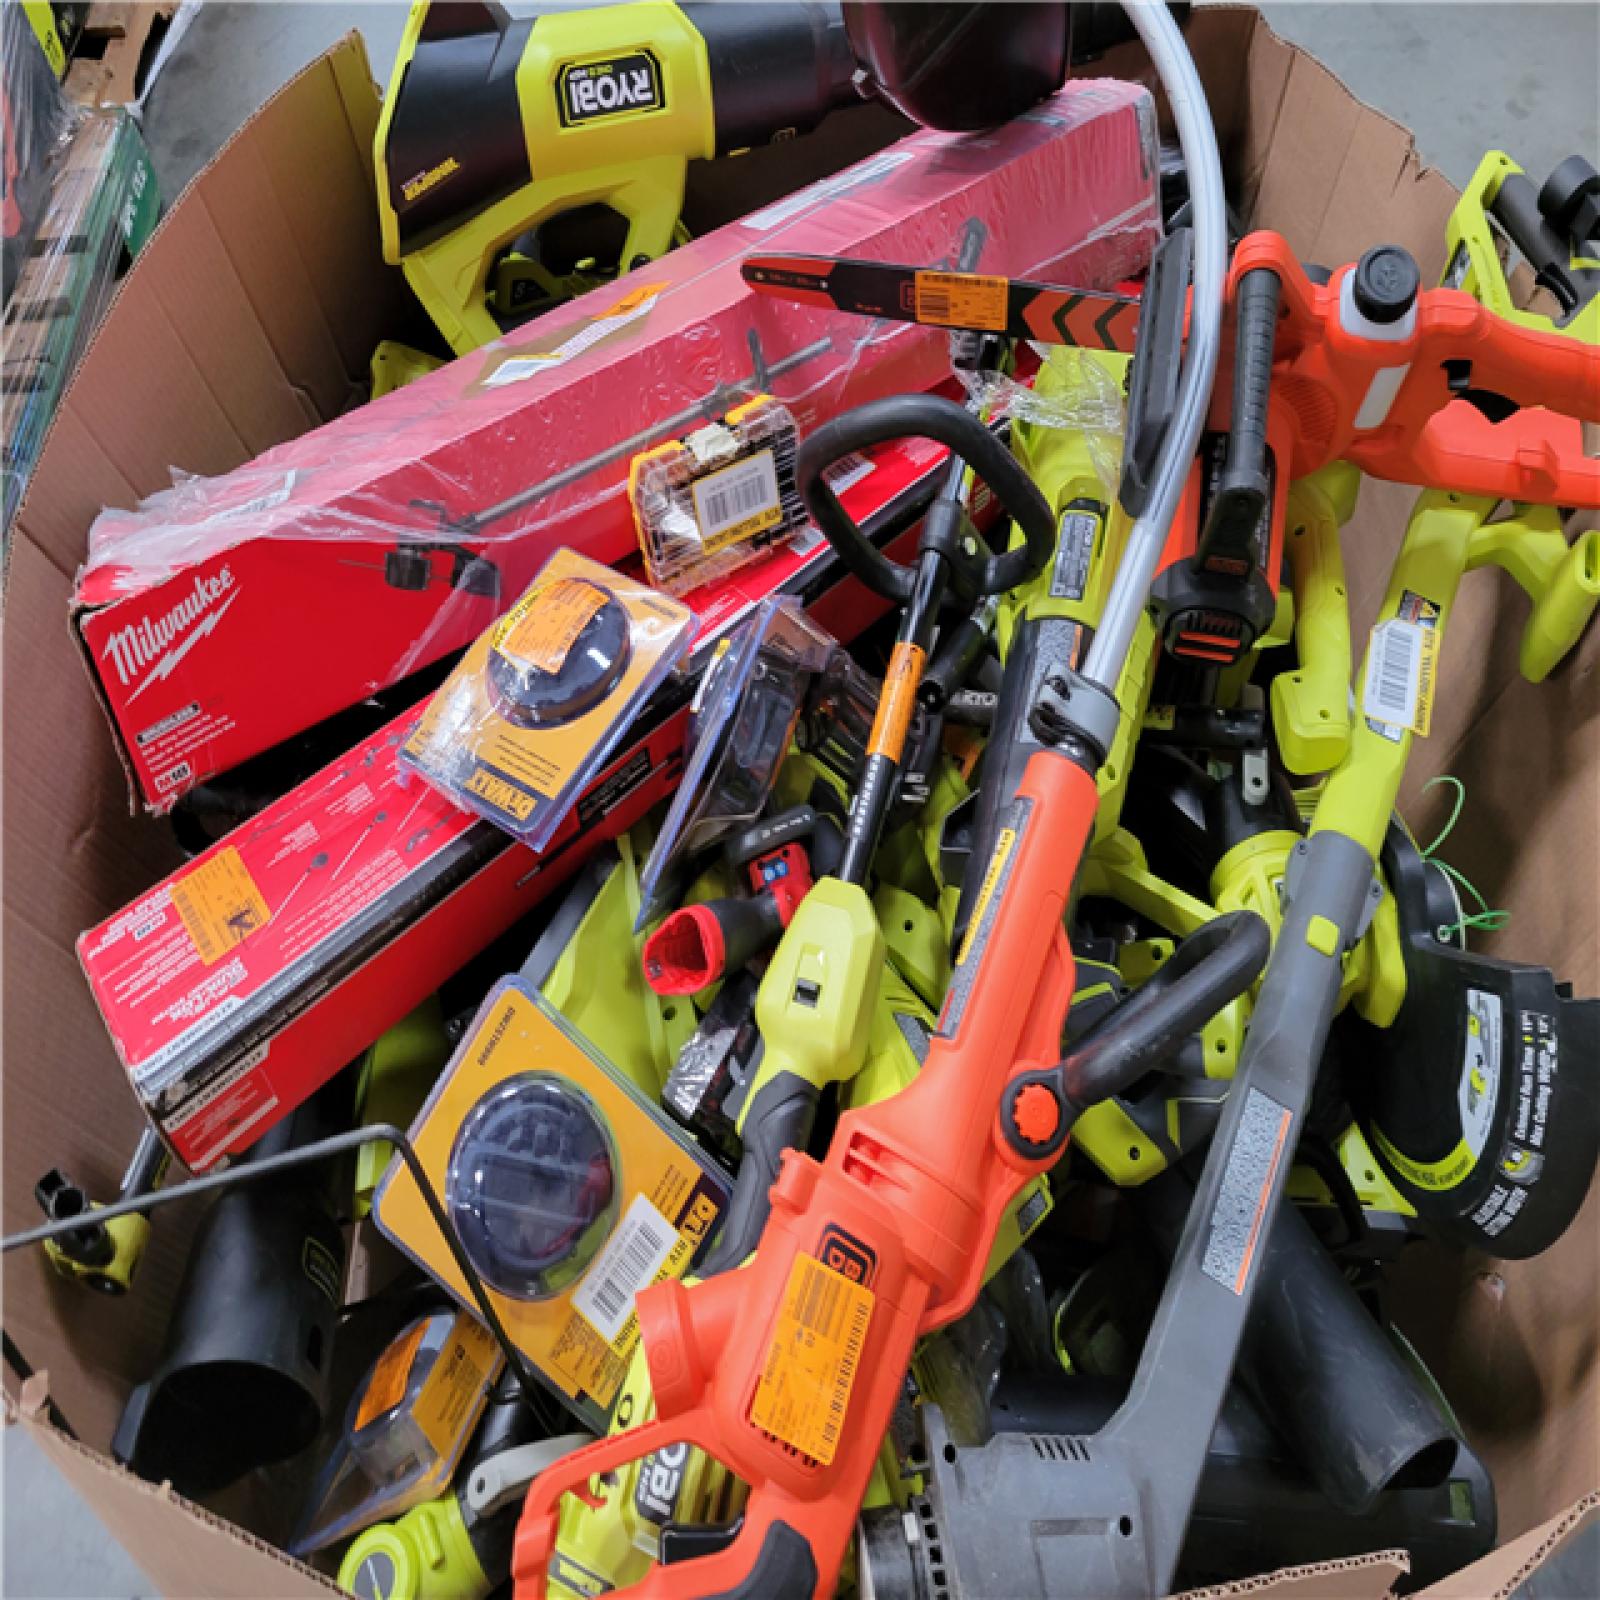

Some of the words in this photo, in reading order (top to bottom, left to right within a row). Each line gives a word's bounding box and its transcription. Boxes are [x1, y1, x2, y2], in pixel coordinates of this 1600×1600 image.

[570, 68, 653, 114] RYOBI
[101, 562, 235, 685] Milwaukee
[462, 767, 537, 822] DEWALT
[1515, 1095, 1530, 1140] Extended
